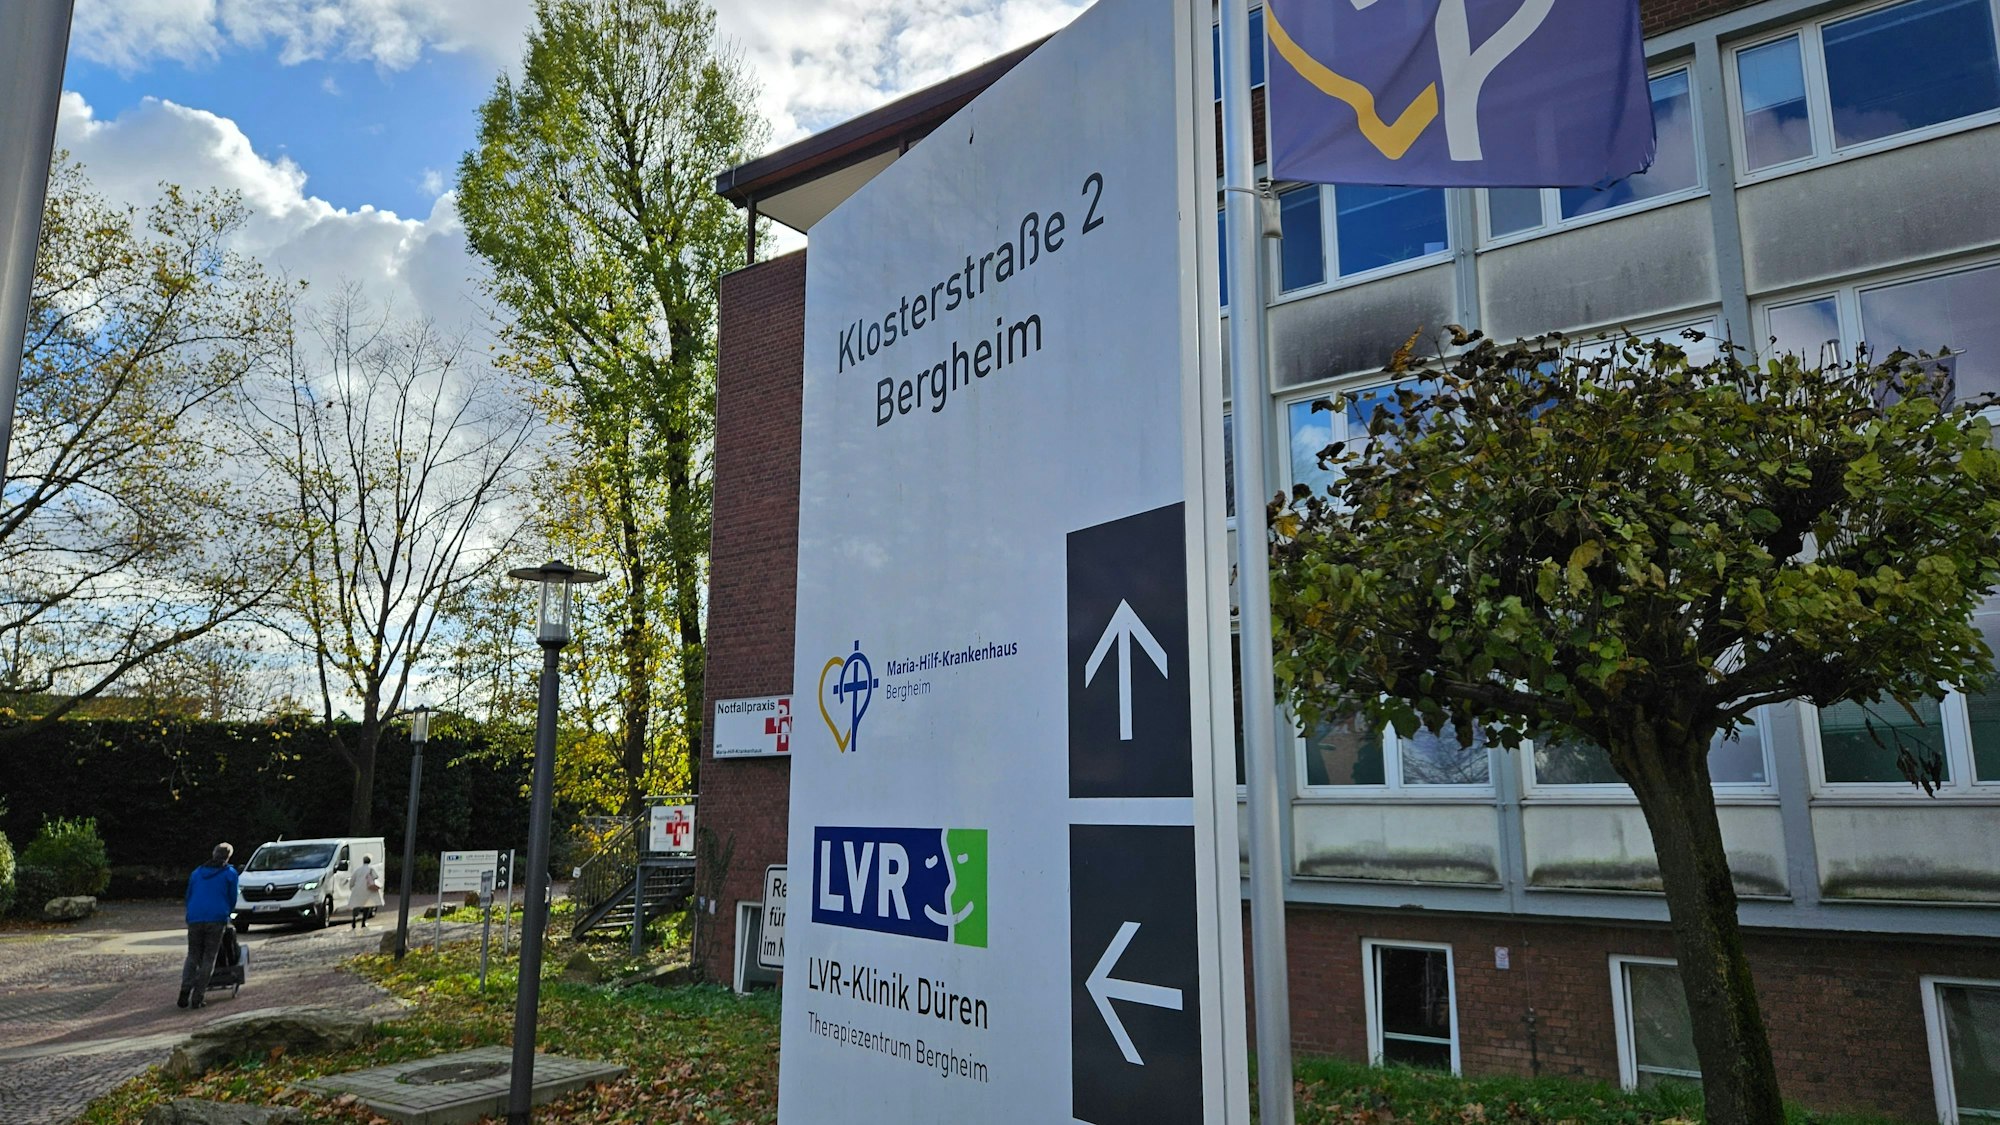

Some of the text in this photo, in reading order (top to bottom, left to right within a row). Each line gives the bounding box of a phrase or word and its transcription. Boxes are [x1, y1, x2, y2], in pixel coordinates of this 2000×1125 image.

[838, 172, 1104, 374] Klosterstraße 2
[876, 314, 1042, 427] Bergheim
[886, 641, 1018, 677] Maria-Hilf-Krankenhaus
[717, 700, 776, 715] Notfallpraxis
[886, 678, 931, 702] Bergheim
[772, 878, 787, 898] Re
[819, 840, 911, 921] LVR
[763, 936, 776, 957] im
[808, 957, 988, 1030] LVR-Klinik Düren
[808, 1011, 988, 1083] Therapiezentrum Bergheim
